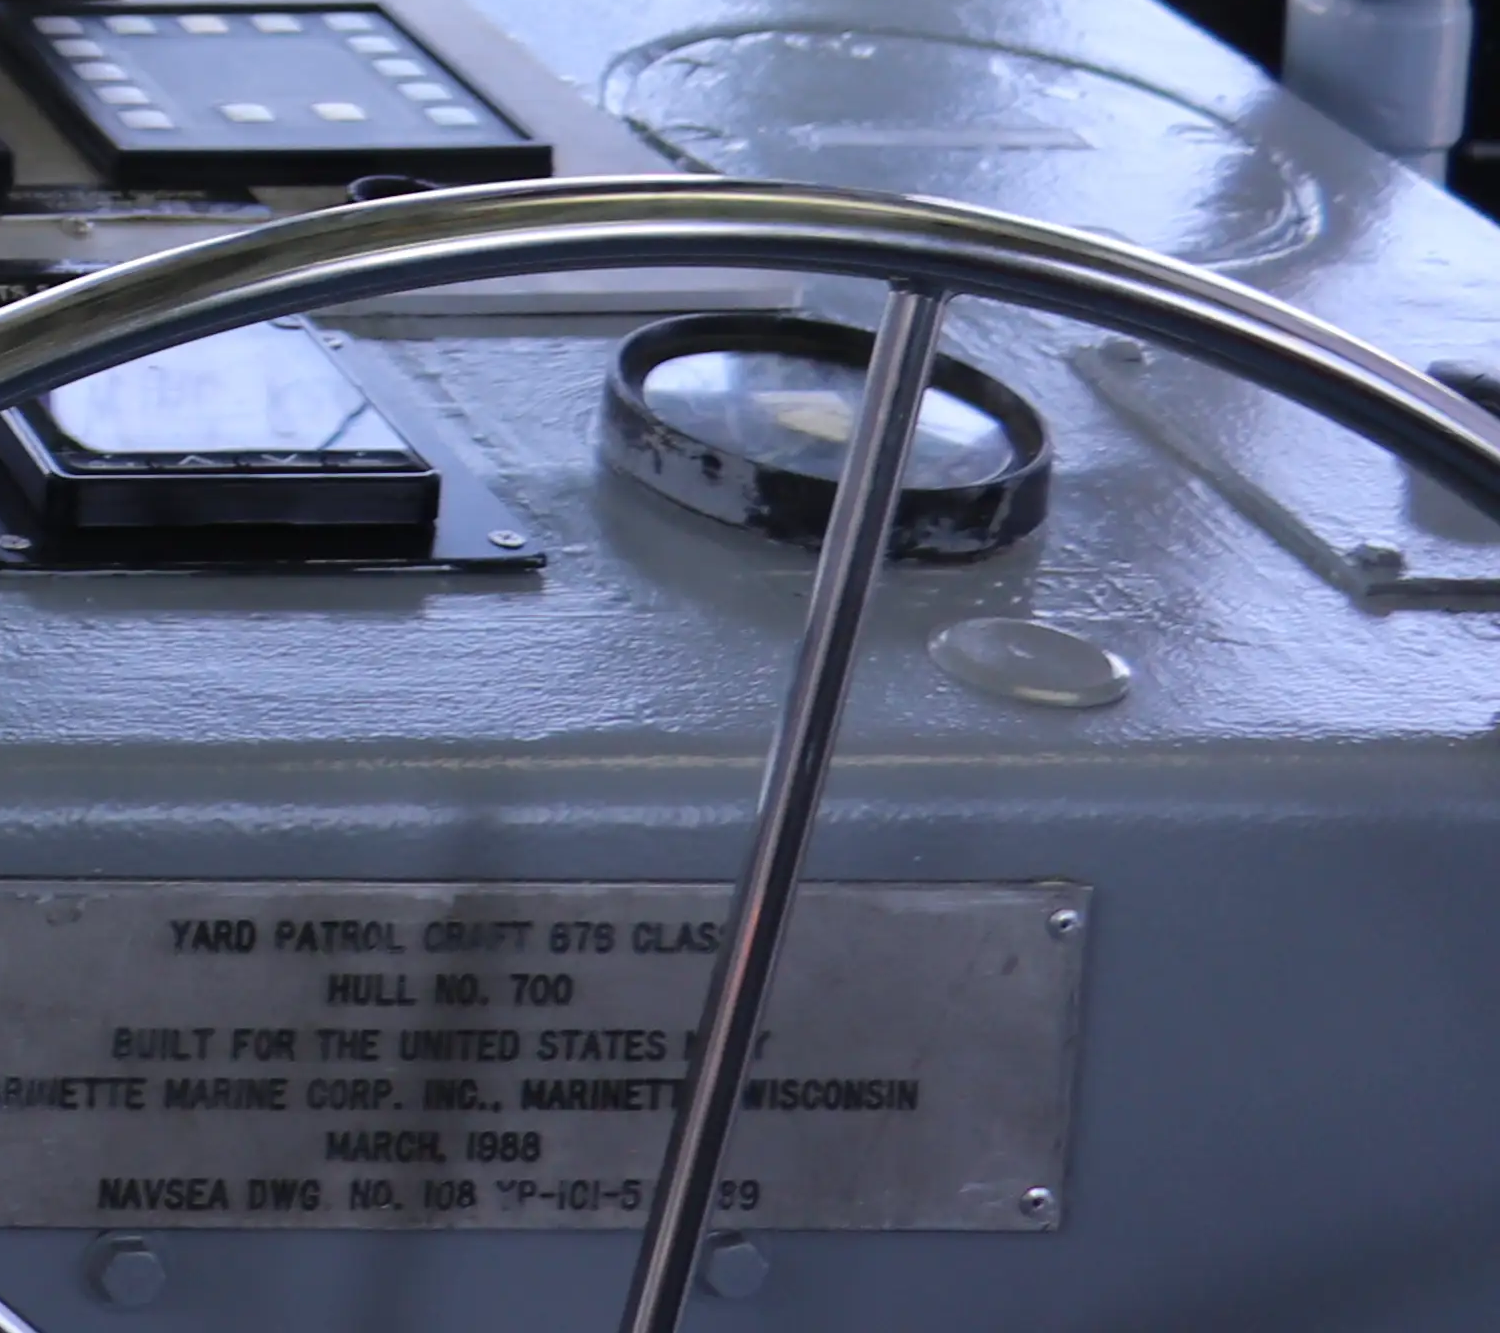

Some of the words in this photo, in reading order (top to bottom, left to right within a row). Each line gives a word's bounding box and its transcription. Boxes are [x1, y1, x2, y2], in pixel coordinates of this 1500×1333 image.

[170, 920, 257, 954] YARD
[275, 920, 406, 954] PATROL
[422, 921, 533, 954] CRAFT
[632, 922, 726, 955] CLAS
[327, 974, 417, 1006] HULL
[435, 974, 489, 1006] NO.
[510, 974, 573, 1006] 700
[112, 1029, 213, 1062] BUILT
[230, 1030, 296, 1062] FOR
[319, 1029, 380, 1061] THE
[400, 1029, 520, 1062] UNITED
[536, 1029, 667, 1062] STATES
[165, 1078, 289, 1111] MARINE
[306, 1078, 403, 1111] CORP.
[521, 1079, 690, 1111] MARINETT
[741, 1079, 919, 1111] WISCONSIN
[467, 1132, 542, 1164] 1988
[98, 1179, 230, 1211] NAVSEA
[350, 1179, 403, 1211] NO.
[424, 1179, 477, 1211] 108
